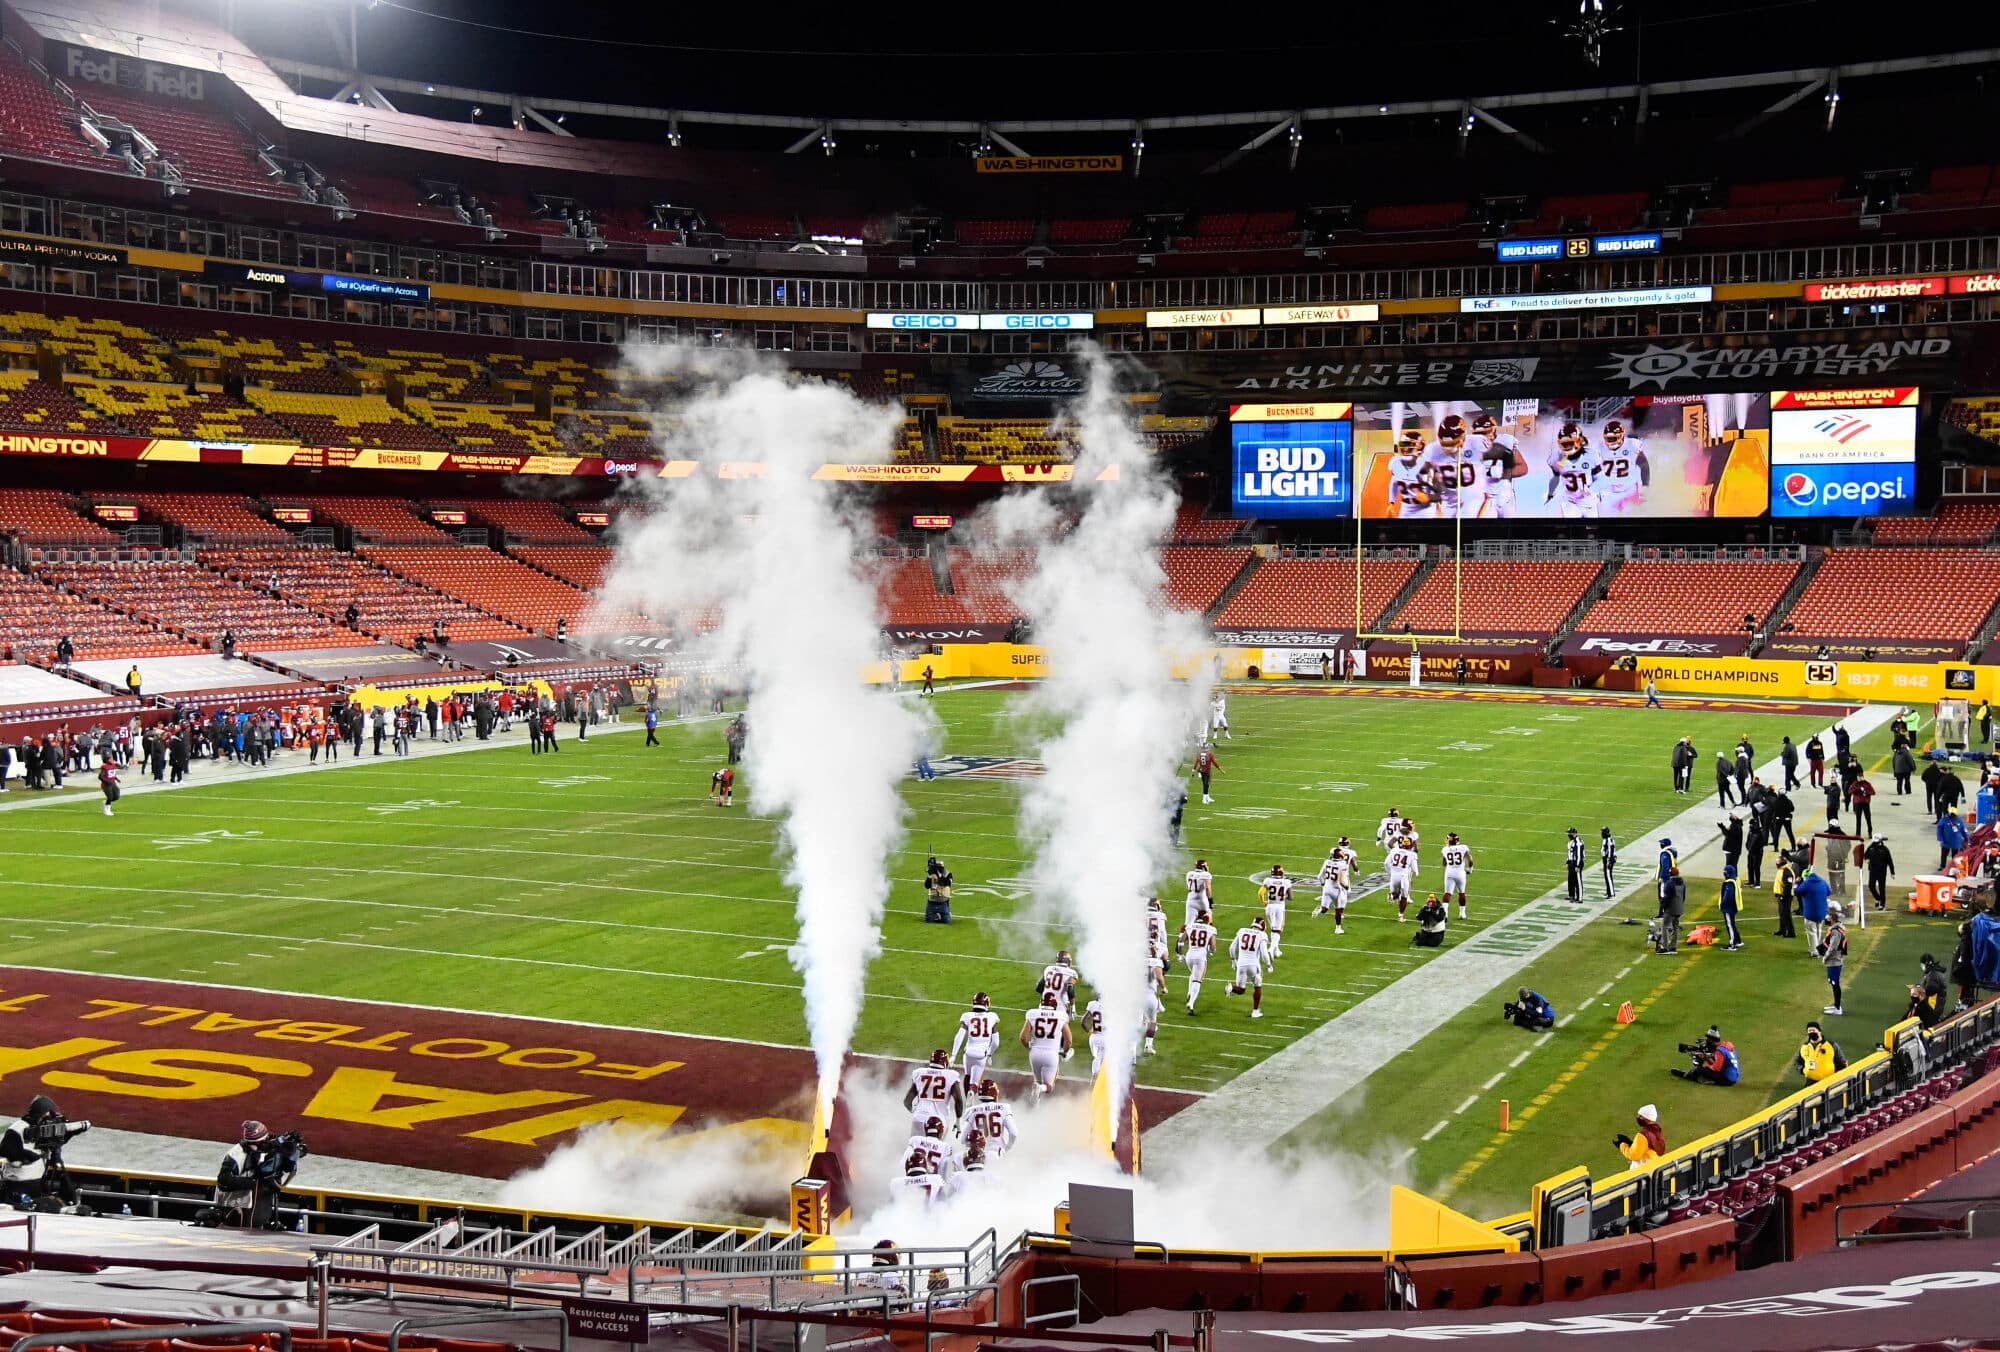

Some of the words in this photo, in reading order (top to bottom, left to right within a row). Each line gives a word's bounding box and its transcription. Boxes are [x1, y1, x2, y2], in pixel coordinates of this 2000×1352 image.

[983, 157, 1117, 170] WASHINGTON
[0, 241, 31, 251] ULTRA
[35, 244, 81, 257] PREMIUM
[84, 251, 117, 262] VODKA
[1502, 247, 1524, 256] BUD
[1527, 245, 1559, 255] LIGHT
[1570, 240, 1587, 254] 25
[1597, 242, 1622, 251] BUD
[1623, 239, 1655, 250] LIGHT
[247, 269, 285, 284] Acronis
[395, 287, 418, 296] Acronis
[1820, 283, 1924, 299] ticketmaster
[1474, 300, 1501, 309] FedEx
[1512, 299, 1537, 307] Proud
[1552, 297, 1582, 306] deliver
[1585, 296, 1598, 304] for
[1601, 296, 1616, 304] the
[1617, 293, 1662, 305] burgundy
[892, 314, 957, 328] GEICO
[1006, 314, 1071, 328] GEICO
[1172, 313, 1218, 323] SAFEWAY
[1288, 310, 1334, 320] SAFEWAY
[1714, 338, 1950, 364] MARYLAND
[1285, 363, 1453, 377] UNITED
[1706, 357, 1898, 378] LOTTERY
[1232, 373, 1449, 389] AIRLINES
[1794, 390, 1896, 401] WASHINGTON
[1266, 407, 1314, 416] BUCCANEERS
[378, 454, 421, 465] BUCCANEERS
[451, 455, 520, 466] WASHINGTON
[1257, 448, 1326, 472] BUD
[616, 463, 637, 473] pepsi
[1602, 459, 1629, 478] 72
[1244, 471, 1339, 497] LIGHT
[1564, 473, 1587, 492] 31
[1823, 477, 1904, 505] pepsi
[896, 629, 984, 640] INOVA
[1581, 638, 1718, 653] FedEx
[1641, 668, 1690, 681] WORLD
[1694, 670, 1779, 683] CHAMPIONS
[1811, 665, 1832, 681] 25
[1846, 673, 1881, 686] 1937
[1893, 674, 1928, 687] 1942
[1392, 853, 1408, 868] 94
[1447, 852, 1462, 865] 93
[1325, 865, 1339, 881] 55
[1188, 878, 1200, 893] 71
[1268, 885, 1285, 901] 24
[1937, 886, 1950, 903] G
[1465, 904, 1593, 957] INSPIRE
[1190, 929, 1207, 948] 48
[1241, 934, 1257, 952] 91
[970, 1017, 989, 1038] 31
[1034, 1017, 1058, 1039] 67
[79, 999, 686, 1081] FOOTBALL
[920, 1075, 946, 1100] 72
[975, 1111, 1002, 1138] 96
[569, 1306, 616, 1320] Restricted
[618, 1312, 640, 1322] Area
[579, 1320, 594, 1329] NO
[596, 1322, 629, 1332] ACCESS
